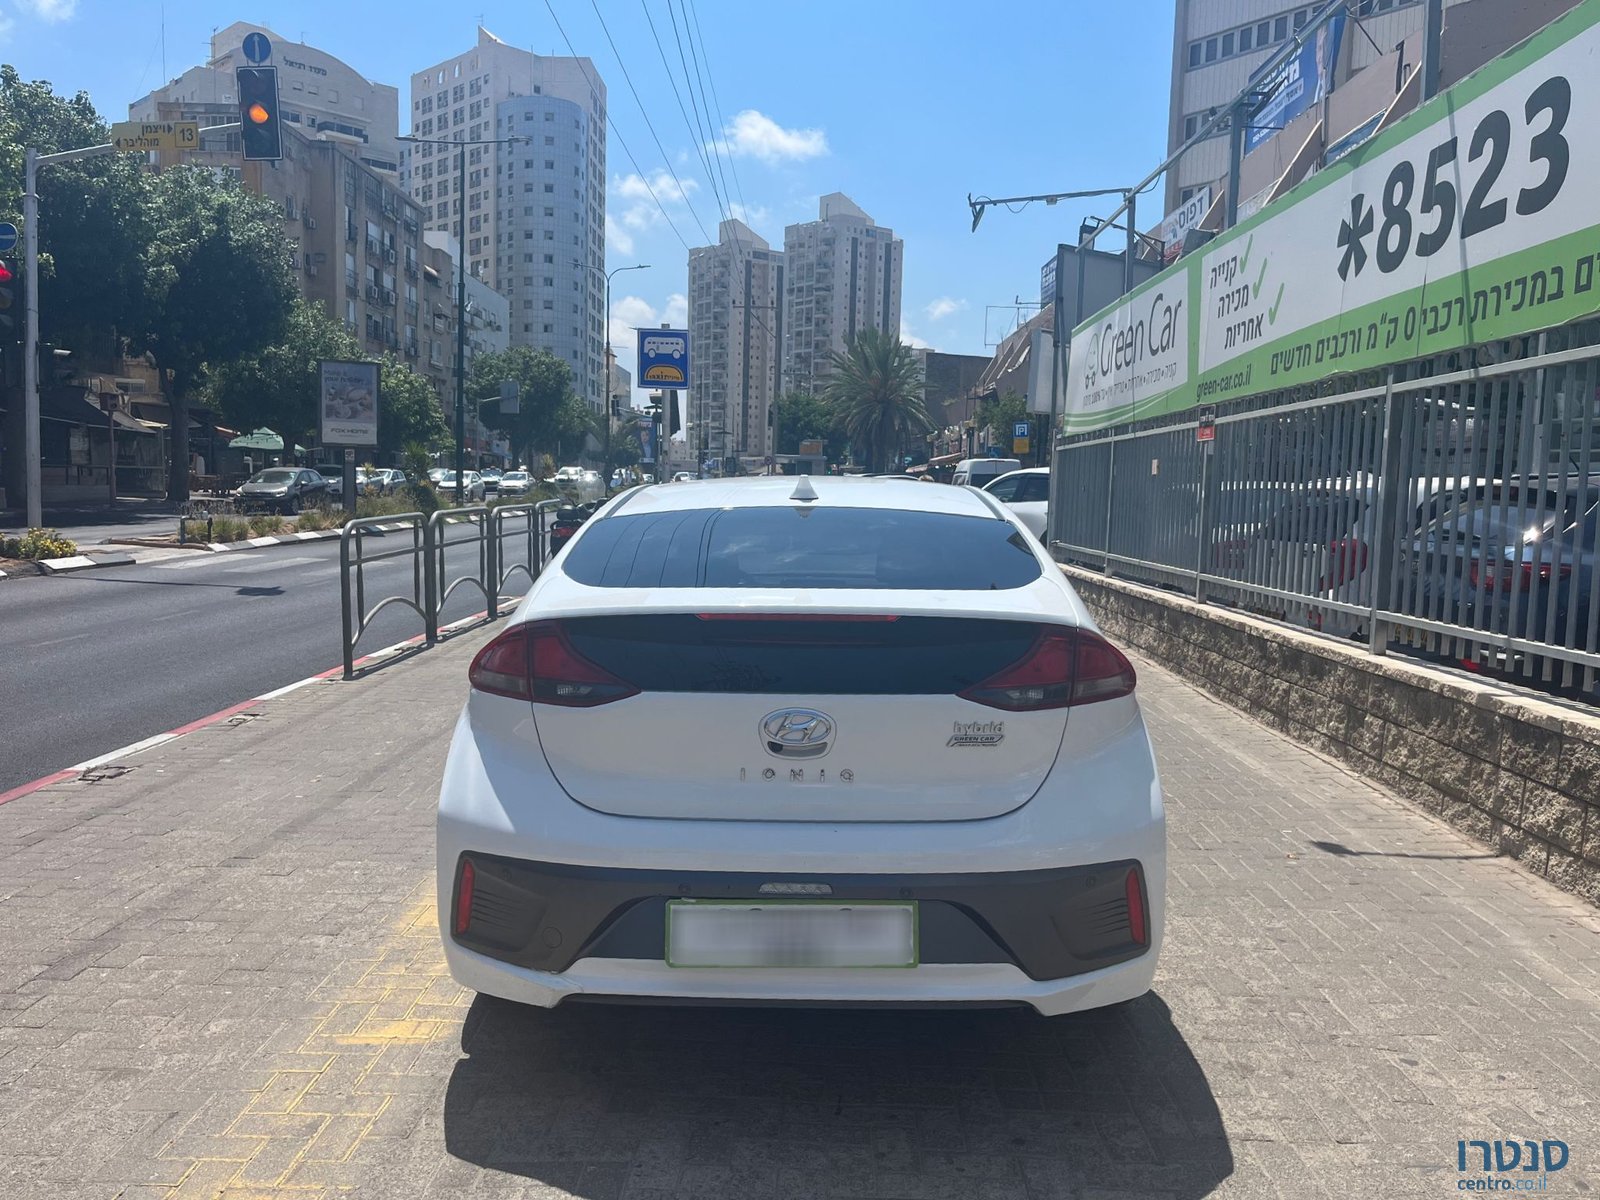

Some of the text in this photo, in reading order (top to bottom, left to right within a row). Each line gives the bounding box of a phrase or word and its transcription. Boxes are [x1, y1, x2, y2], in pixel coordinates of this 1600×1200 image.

[124, 135, 160, 148] מוהליבר
[141, 124, 166, 137] ויצמן
[180, 128, 194, 142] 13
[1179, 196, 1204, 229] דפוס
[1210, 255, 1237, 290] קנייה
[1217, 284, 1249, 319] מכירה
[1469, 264, 1564, 324] במכירת
[1224, 313, 1264, 350] אחריות
[1403, 305, 1416, 342] 0
[1421, 295, 1465, 336] רכבי
[1101, 293, 1182, 377] Green Car
[1315, 327, 1362, 364] ורכבים
[1270, 341, 1312, 375] חדשים
[1196, 363, 1252, 402] green-car.co.il
[953, 720, 1005, 737] hybrid
[740, 767, 854, 783] IONIQ
